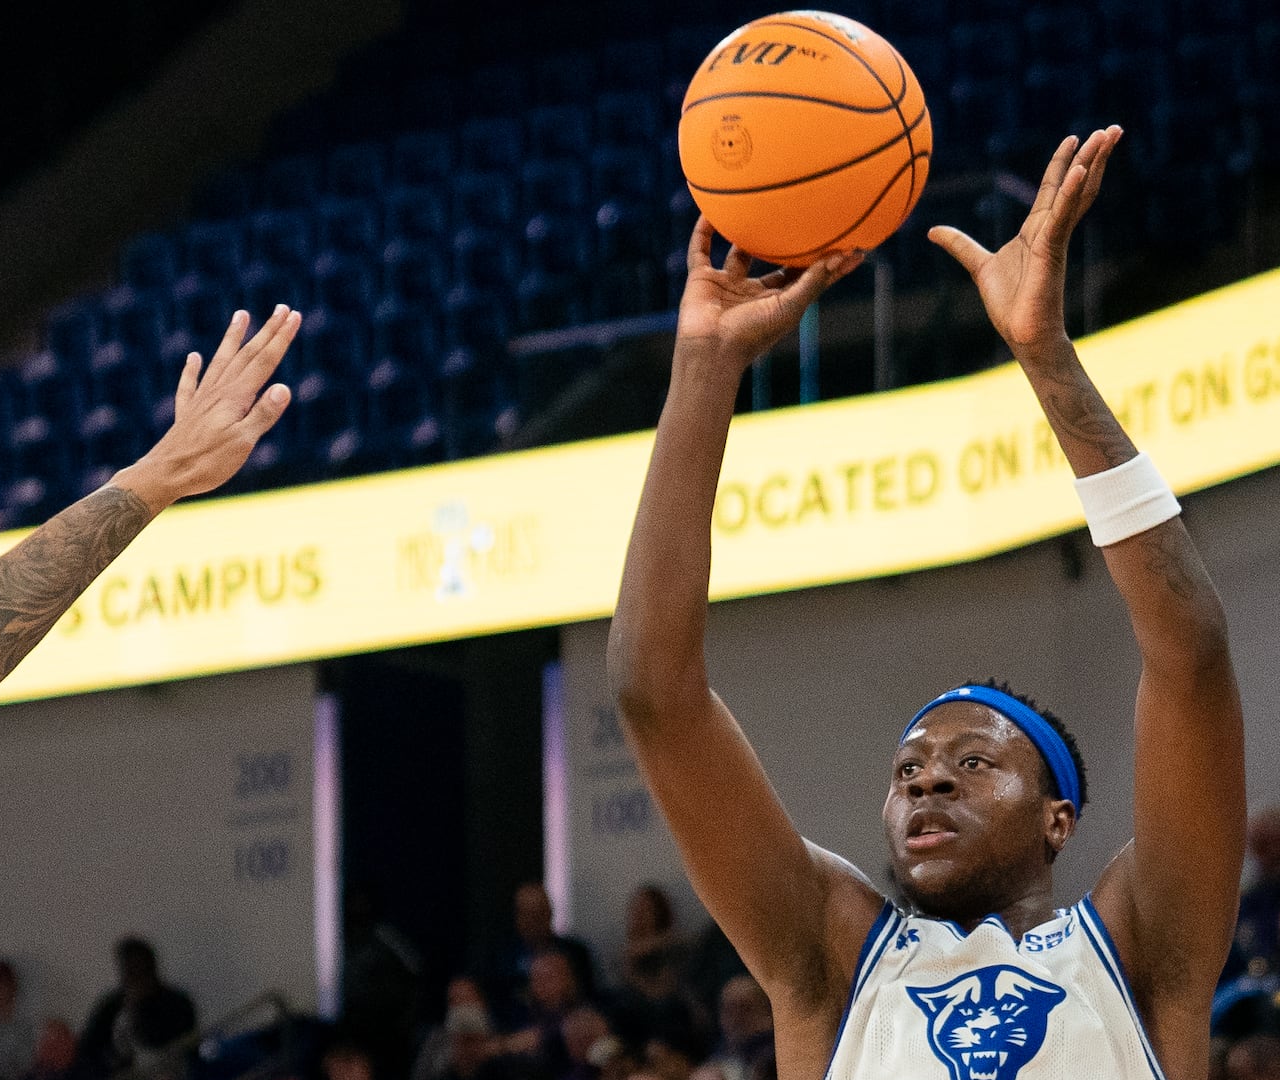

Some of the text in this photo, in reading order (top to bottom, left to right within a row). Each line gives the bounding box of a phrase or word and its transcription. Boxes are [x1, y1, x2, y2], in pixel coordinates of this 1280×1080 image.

[1171, 354, 1232, 426] ON
[716, 427, 1019, 535] OCATED ON
[100, 545, 323, 627] CAMPUS
